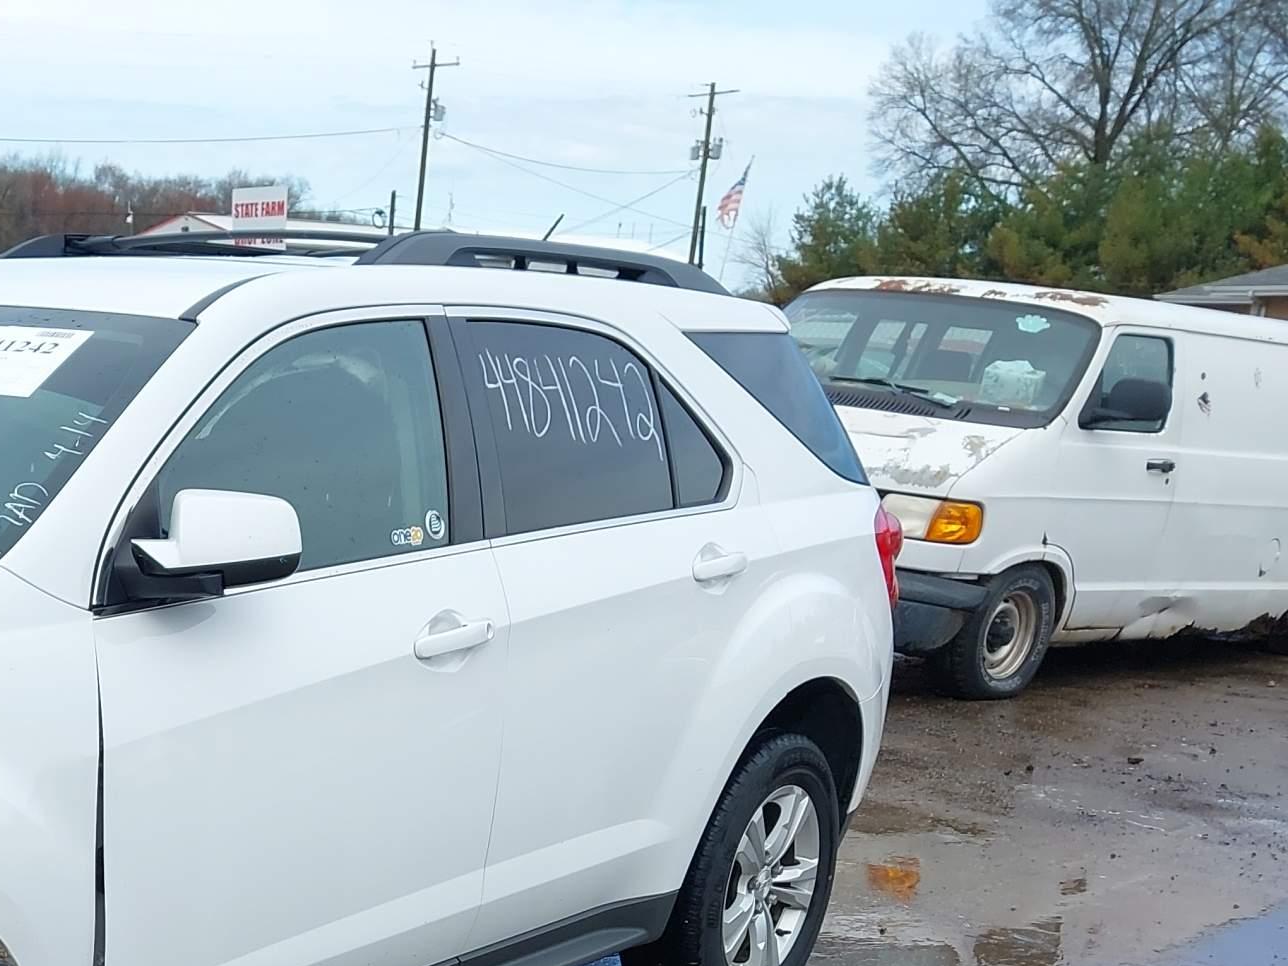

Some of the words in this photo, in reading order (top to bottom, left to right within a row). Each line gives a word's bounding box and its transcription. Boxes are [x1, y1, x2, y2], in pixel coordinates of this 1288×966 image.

[234, 203, 258, 218] STATE
[261, 200, 284, 217] FARM
[478, 348, 664, 462] 44841242
